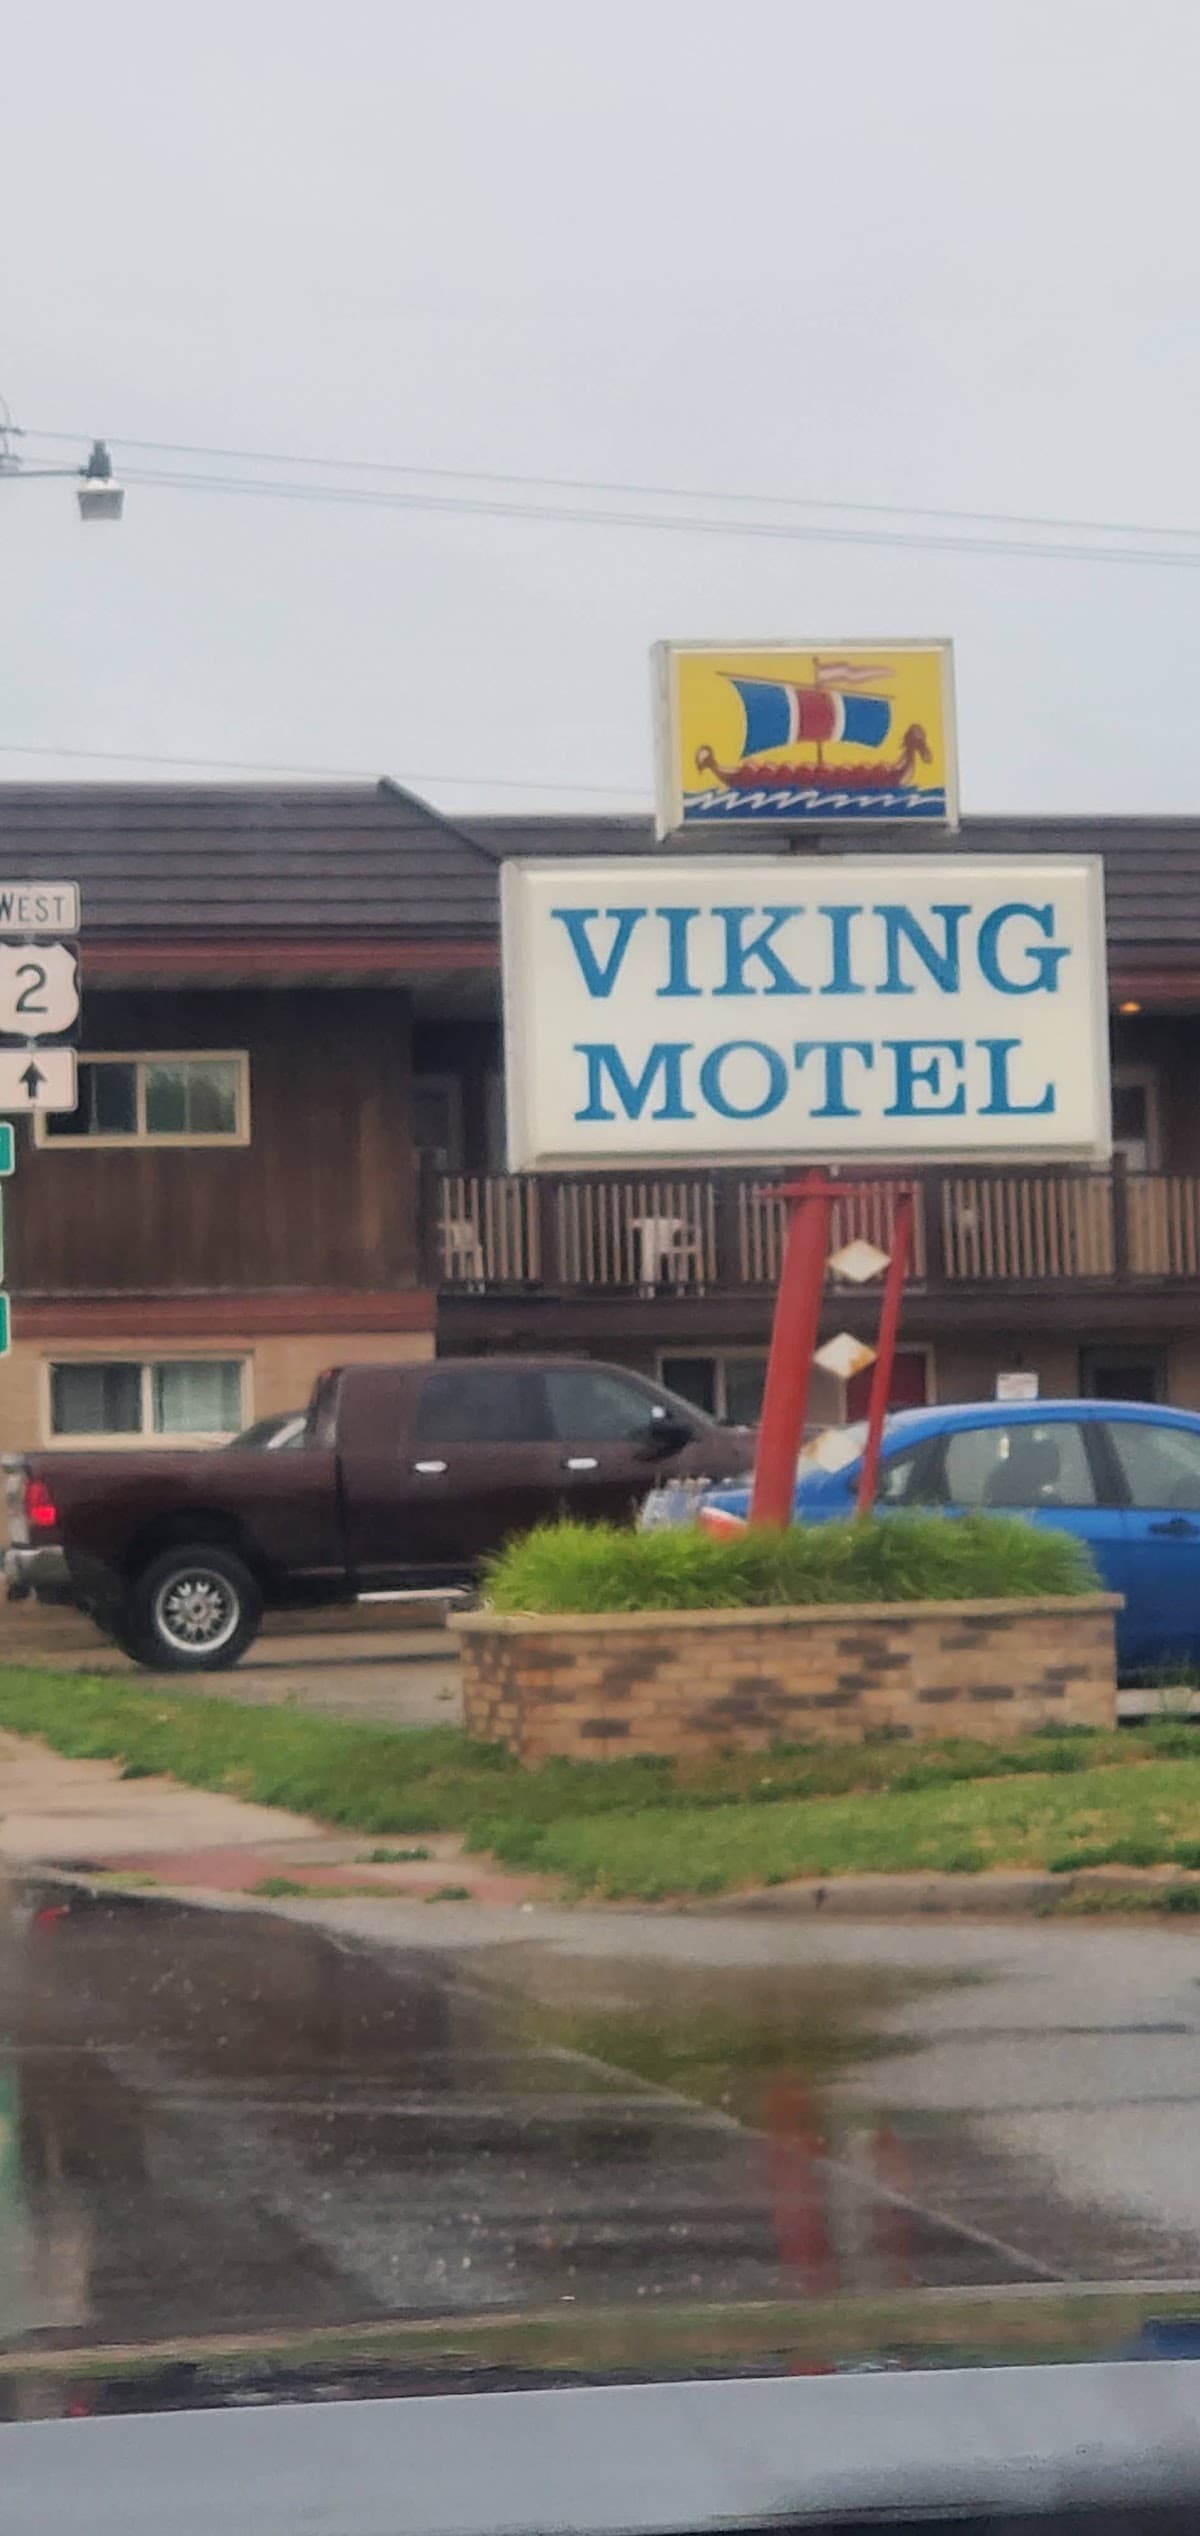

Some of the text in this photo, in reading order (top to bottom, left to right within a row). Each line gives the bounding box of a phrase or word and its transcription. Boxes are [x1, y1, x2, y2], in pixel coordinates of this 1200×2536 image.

[15, 963, 48, 1013] 2
[551, 903, 1070, 998] VIKING
[574, 1038, 1055, 1121] MOTEL
